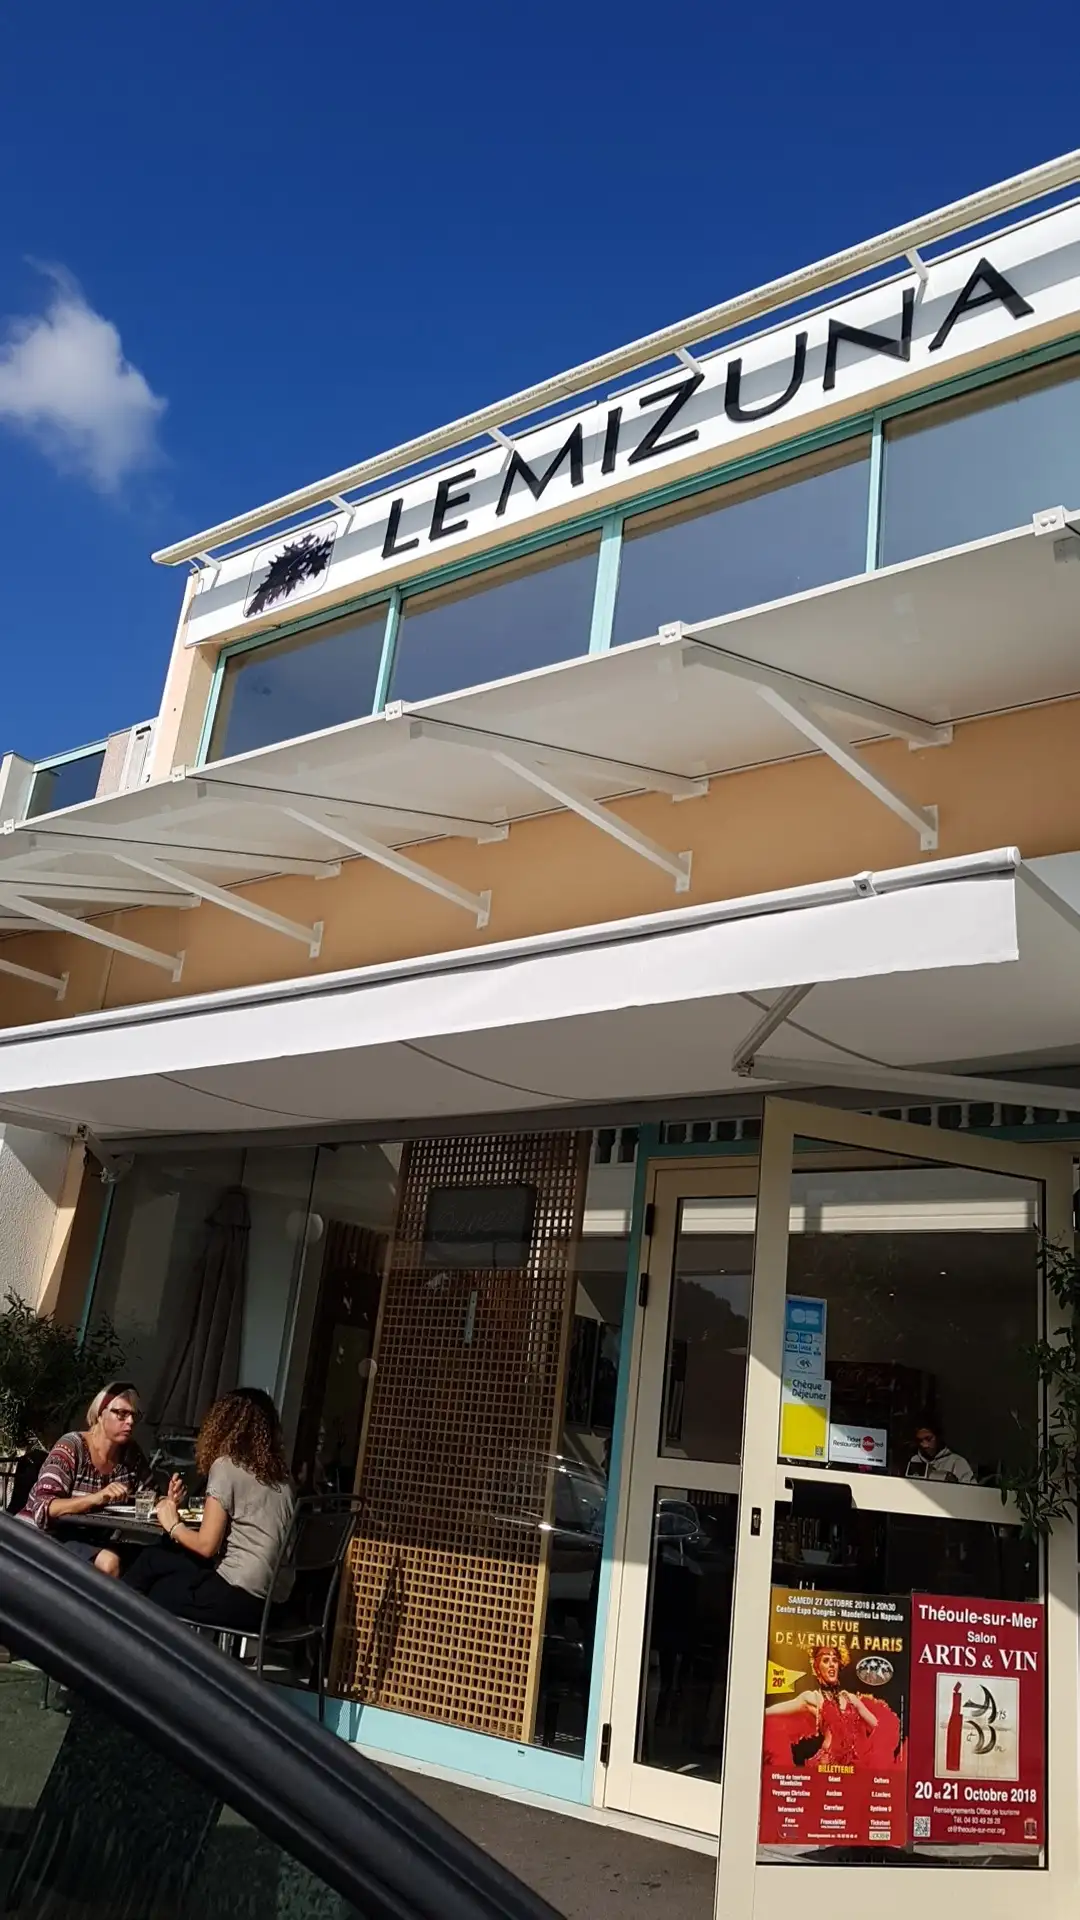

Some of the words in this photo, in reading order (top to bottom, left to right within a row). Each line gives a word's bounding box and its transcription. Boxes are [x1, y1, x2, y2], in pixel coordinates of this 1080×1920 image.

[381, 467, 477, 559] LE
[495, 257, 1034, 516] MIZUNA
[792, 1379, 822, 1391] Chèque
[791, 1388, 827, 1400] Déjeuner
[788, 1595, 813, 1605] SAMEDI
[814, 1597, 823, 1606] 27
[824, 1598, 853, 1609] OCTOBRE
[854, 1601, 870, 1610] 2018
[876, 1602, 896, 1611] 20h30
[776, 1605, 796, 1614] Centre
[797, 1606, 811, 1616] Expo
[812, 1607, 836, 1618] Congrès
[841, 1609, 871, 1619] Mandelieu
[872, 1611, 879, 1620] La
[880, 1612, 904, 1622] Napoule
[919, 1604, 1038, 1629] Théoule-sur-Mer
[822, 1620, 859, 1633] REVUE
[775, 1631, 793, 1645] DE
[797, 1633, 846, 1648] VENISE
[864, 1636, 903, 1652] PARIS
[967, 1630, 997, 1644] Salon
[918, 1643, 977, 1668] ARTS
[982, 1654, 994, 1669] &
[999, 1648, 1038, 1672] VIN
[818, 1764, 855, 1774] BILLETTERIE
[914, 1781, 933, 1799] 20
[934, 1791, 941, 1799] et
[942, 1782, 958, 1800] 21
[964, 1786, 1008, 1802] Octobre
[1010, 1788, 1037, 1803] 2018
[933, 1806, 976, 1816] Renseignements
[976, 1807, 992, 1815] Office
